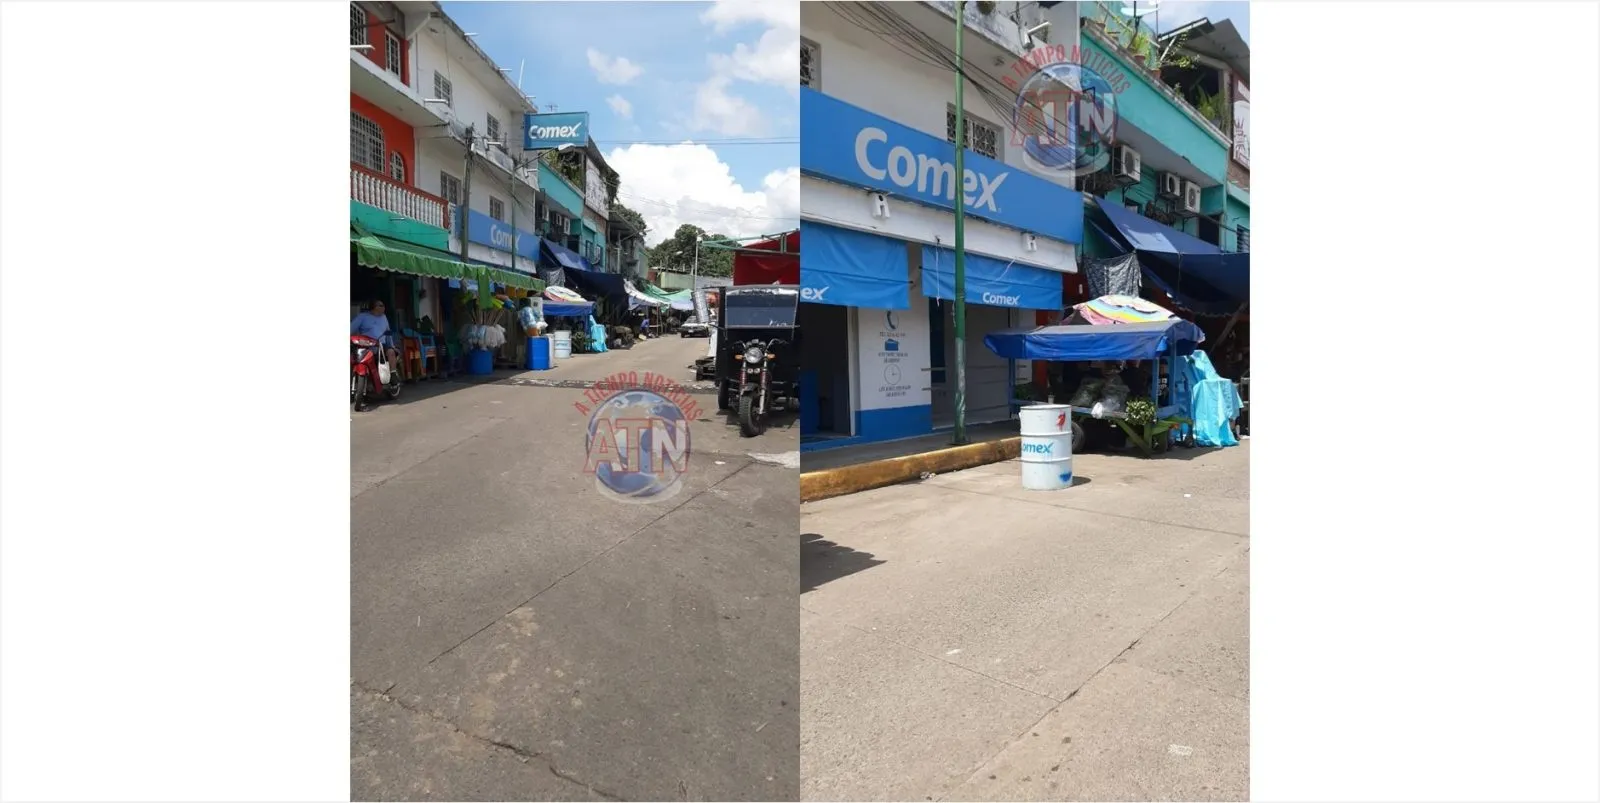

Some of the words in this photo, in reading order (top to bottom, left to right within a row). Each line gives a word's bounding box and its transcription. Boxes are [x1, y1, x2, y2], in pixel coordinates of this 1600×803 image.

[529, 122, 582, 139] Comex
[855, 127, 1010, 212] Comex
[491, 224, 521, 252] Comx
[983, 291, 1021, 305] Comex
[1022, 442, 1054, 454] omex
